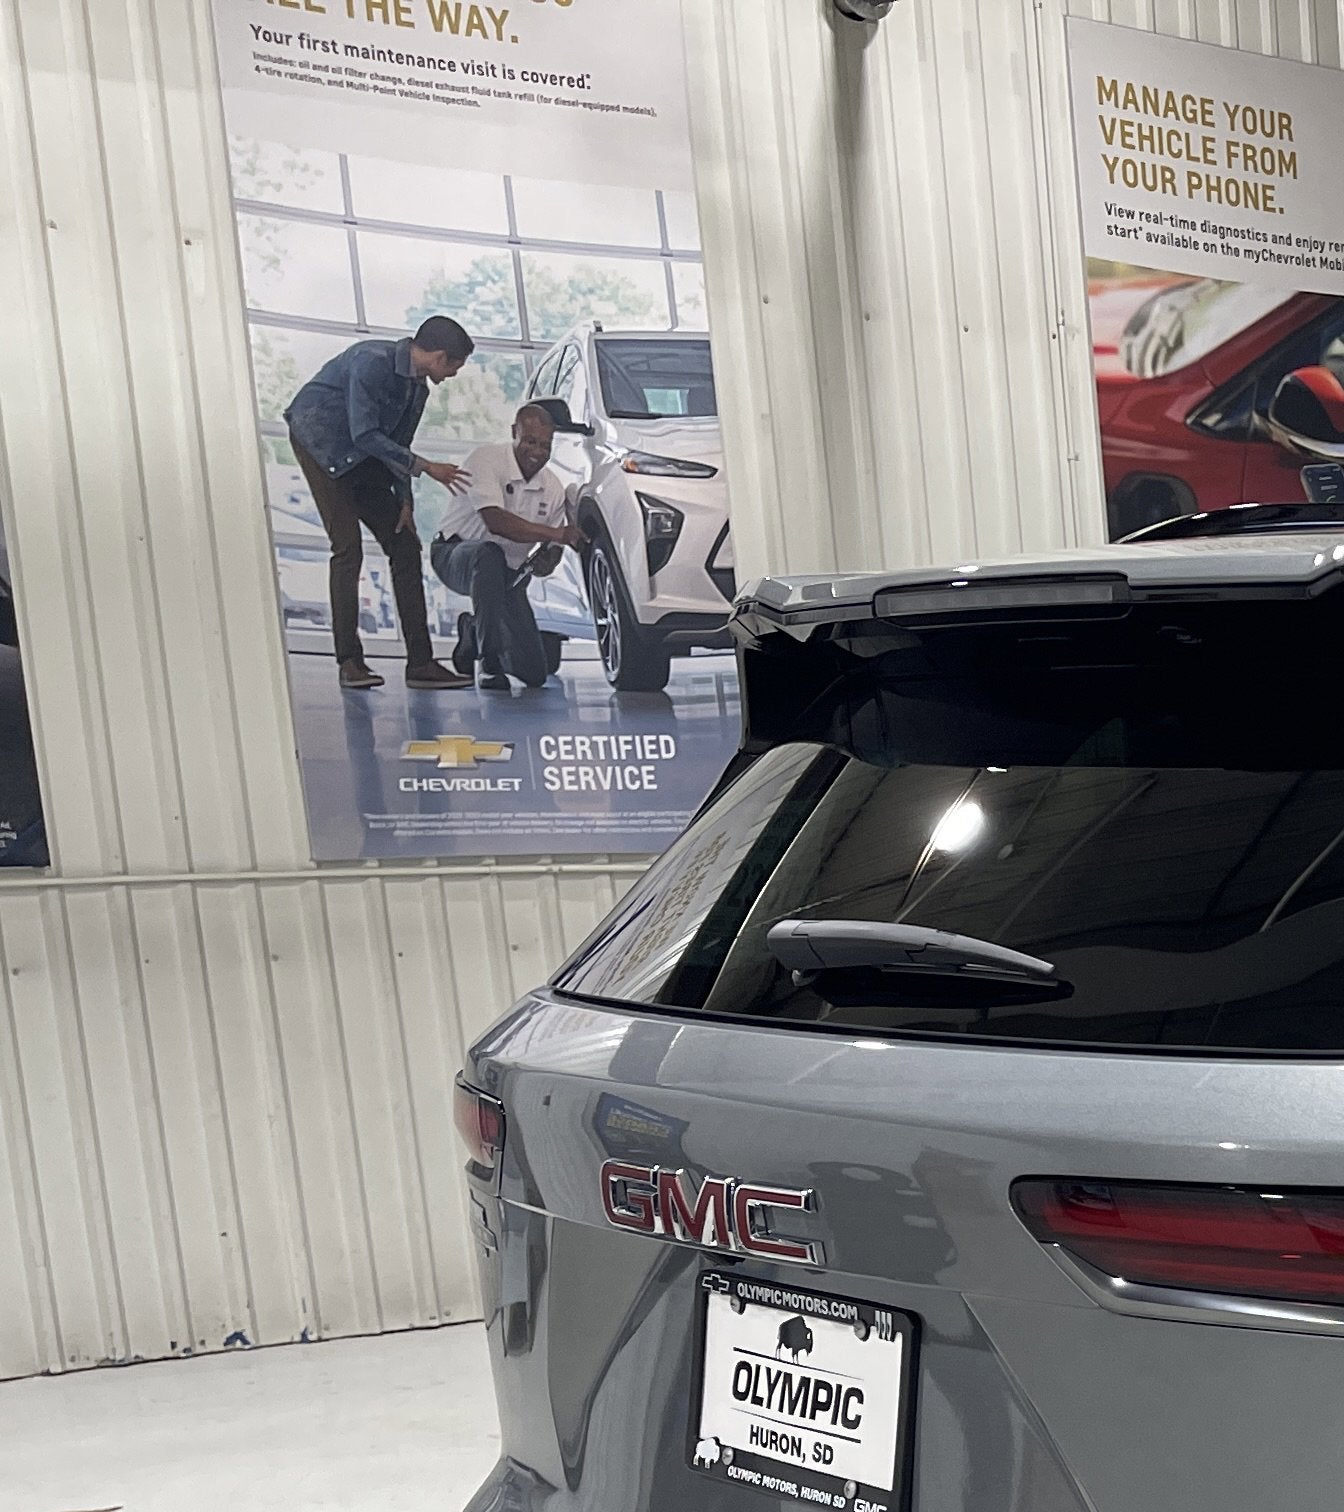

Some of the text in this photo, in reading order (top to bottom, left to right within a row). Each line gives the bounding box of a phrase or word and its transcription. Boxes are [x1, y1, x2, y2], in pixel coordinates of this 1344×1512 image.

[427, 0, 519, 44] WAY.
[249, 23, 292, 46] Your
[298, 31, 339, 55] first
[343, 43, 457, 74] maintenance
[460, 59, 498, 79] visit
[501, 63, 516, 81] is
[252, 51, 296, 67] Includes:
[312, 64, 329, 73] and
[344, 67, 367, 79] filter
[407, 77, 433, 89] diesel
[435, 83, 470, 94] exhaust
[471, 85, 491, 97] fluid
[493, 89, 513, 100] tank
[554, 97, 621, 113] diesel-equipped
[254, 65, 282, 78] 4-tire
[284, 71, 326, 87] rotation,
[327, 79, 344, 89] and
[346, 80, 397, 97] Multi-Point
[398, 88, 431, 102] Vehicle
[1096, 75, 1294, 142] MANAGE YOUR
[1098, 114, 1298, 180] VEHICLE FROM
[1101, 153, 1285, 214] YOUR PHONE.
[1104, 201, 1136, 221] View
[1139, 210, 1197, 232] real-time
[1200, 219, 1268, 243] diagnostics
[1271, 232, 1292, 247] and
[1295, 236, 1326, 254] enjoy
[1145, 231, 1200, 251] available
[1203, 241, 1217, 254] on
[1221, 242, 1240, 258] the
[1243, 248, 1317, 268] myChevrolet
[539, 734, 676, 761] CERTIFIED
[399, 777, 523, 792] CHEVROLET
[543, 765, 658, 791] SERVICE
[601, 1161, 824, 1266] GMC
[737, 1282, 858, 1320] OLYMPICMOTORS.COM
[732, 1360, 864, 1430] OLYMPIC
[750, 1424, 834, 1465] HURON, SD
[727, 1465, 846, 1509] OLYMPIC MOTORS, HURON SD
